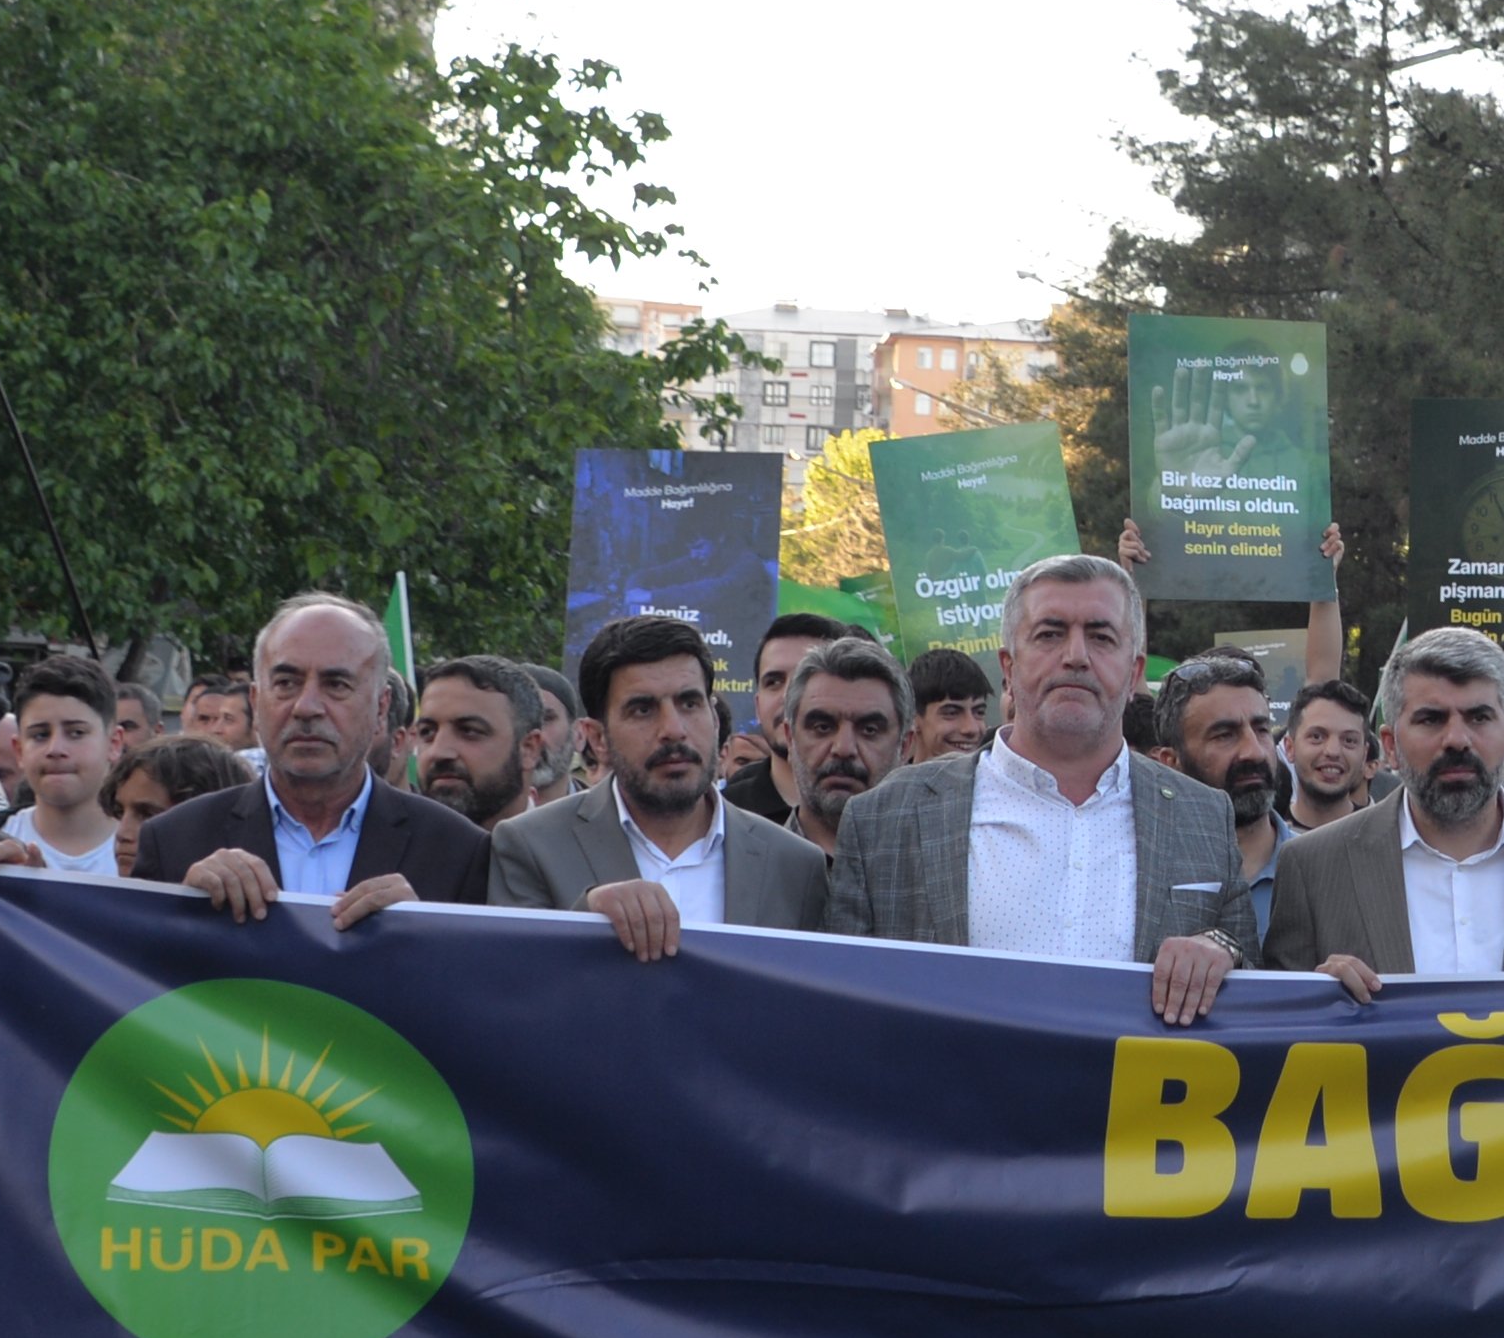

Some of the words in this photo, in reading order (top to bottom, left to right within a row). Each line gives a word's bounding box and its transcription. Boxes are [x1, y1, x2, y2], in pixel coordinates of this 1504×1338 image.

[1177, 357, 1213, 368] Madde
[1213, 370, 1243, 381] Hayır!
[1459, 435, 1496, 445] Madde
[921, 465, 956, 482] Madde
[1161, 471, 1185, 487] Bir
[1191, 472, 1222, 488] kez
[1226, 474, 1297, 491] denedin
[624, 486, 662, 498] Madde
[1161, 494, 1240, 514] bağımlısı
[1245, 495, 1299, 514] oldun.
[1184, 521, 1224, 538] Hayır
[1228, 522, 1281, 537] demek
[1184, 541, 1227, 555] senin
[1231, 542, 1282, 557] elinde!
[915, 572, 981, 599] Özgür
[985, 568, 1023, 589] olm
[936, 603, 1004, 627] istiyor
[1450, 608, 1502, 626] Bugün
[100, 1227, 289, 1273] HÜDA
[312, 1231, 431, 1281] PAR
